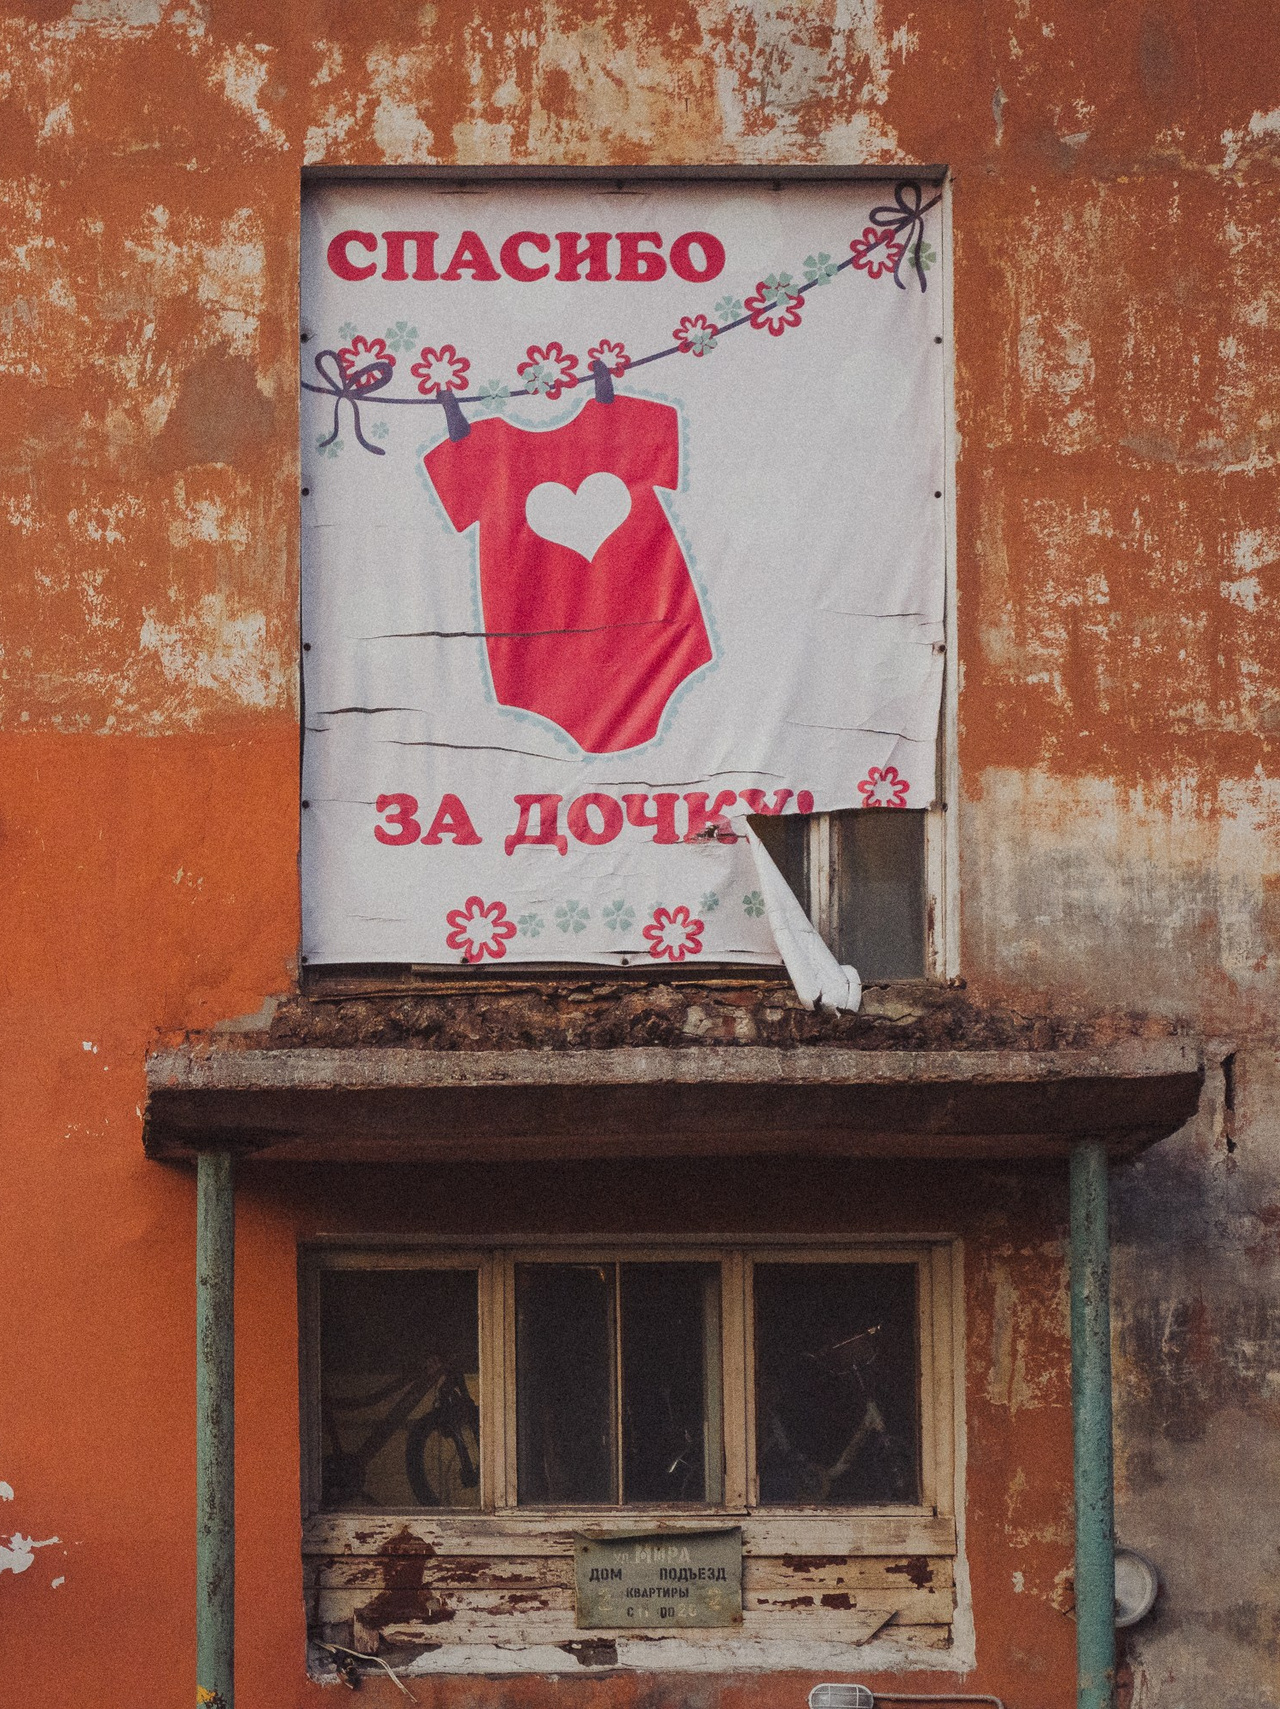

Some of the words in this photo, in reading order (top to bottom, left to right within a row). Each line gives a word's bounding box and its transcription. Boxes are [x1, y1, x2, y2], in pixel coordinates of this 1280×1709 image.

[326, 229, 726, 283] СПАСИБО
[374, 793, 483, 846] ЗА
[589, 1568, 623, 1582] ДОМ
[659, 1567, 727, 1582] ПОДЪЕЗД
[626, 1587, 689, 1598] КВАРТИРЫ
